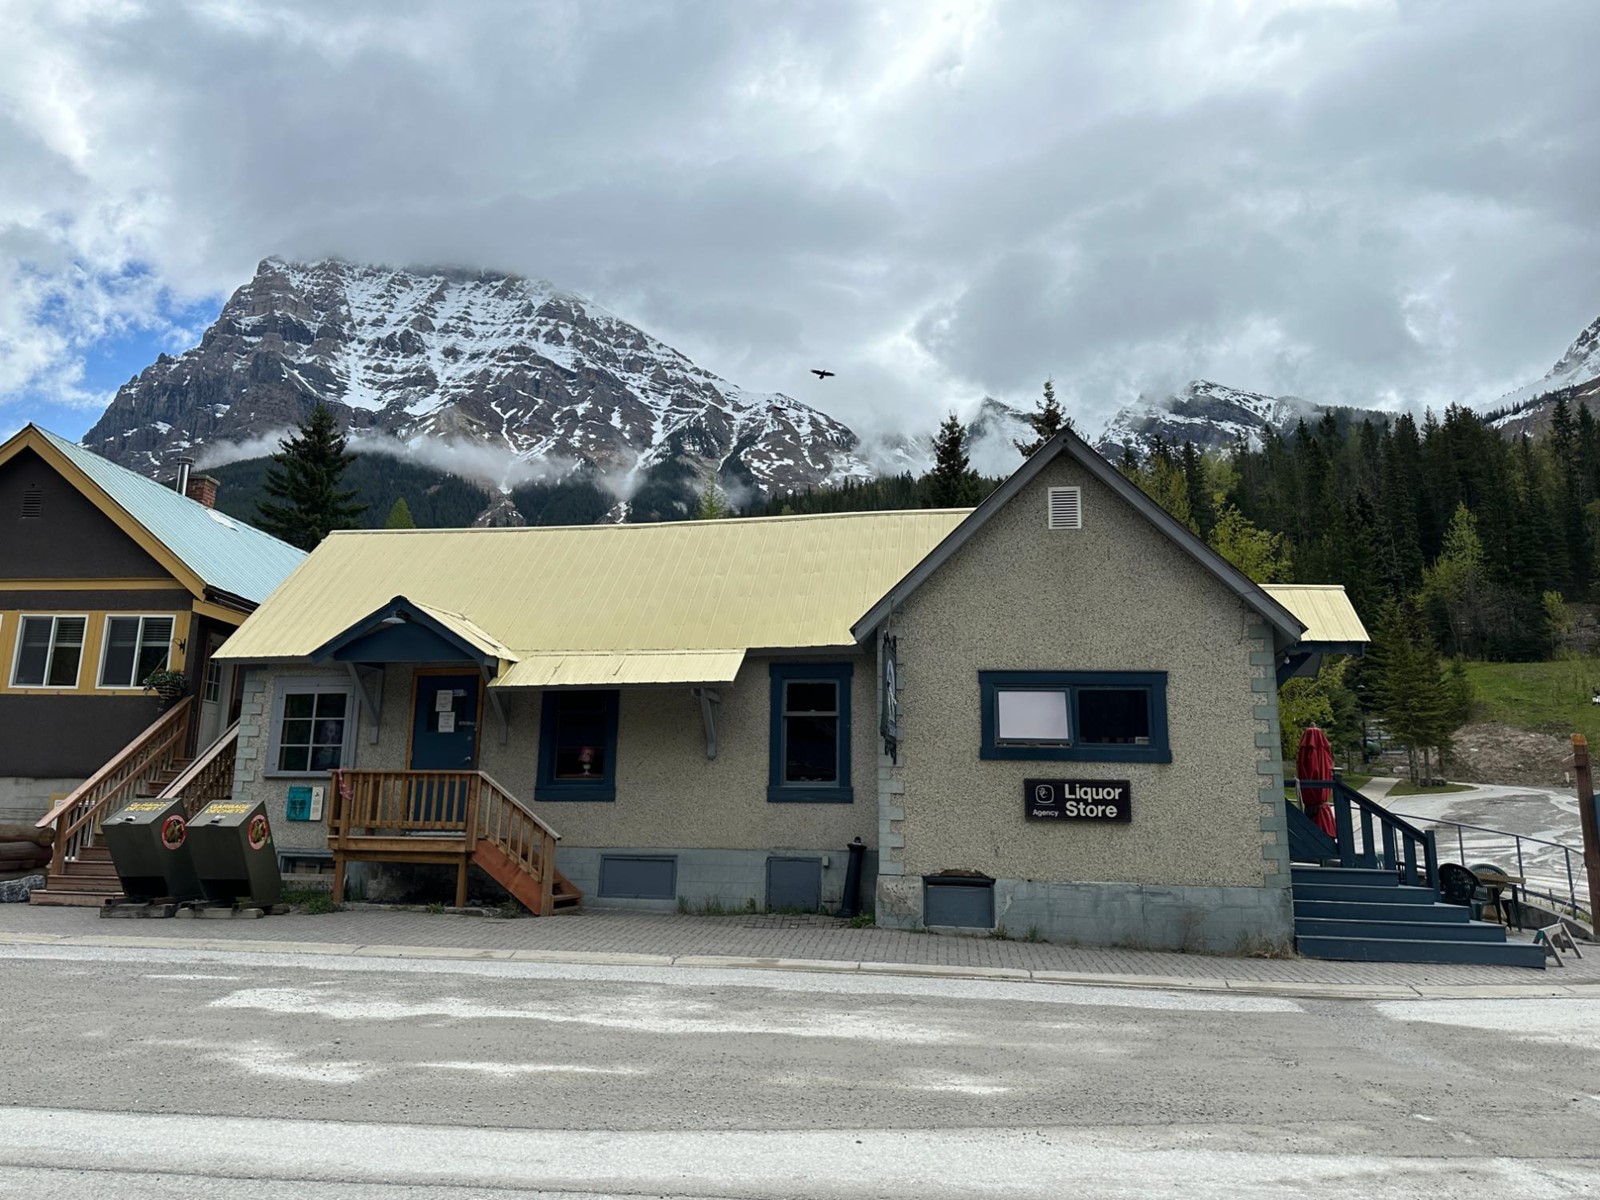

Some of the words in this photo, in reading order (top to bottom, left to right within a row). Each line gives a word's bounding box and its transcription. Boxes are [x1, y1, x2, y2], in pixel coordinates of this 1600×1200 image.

[1064, 783, 1122, 803] Liquor
[1032, 809, 1059, 817] Agency
[1065, 800, 1118, 818] Store
